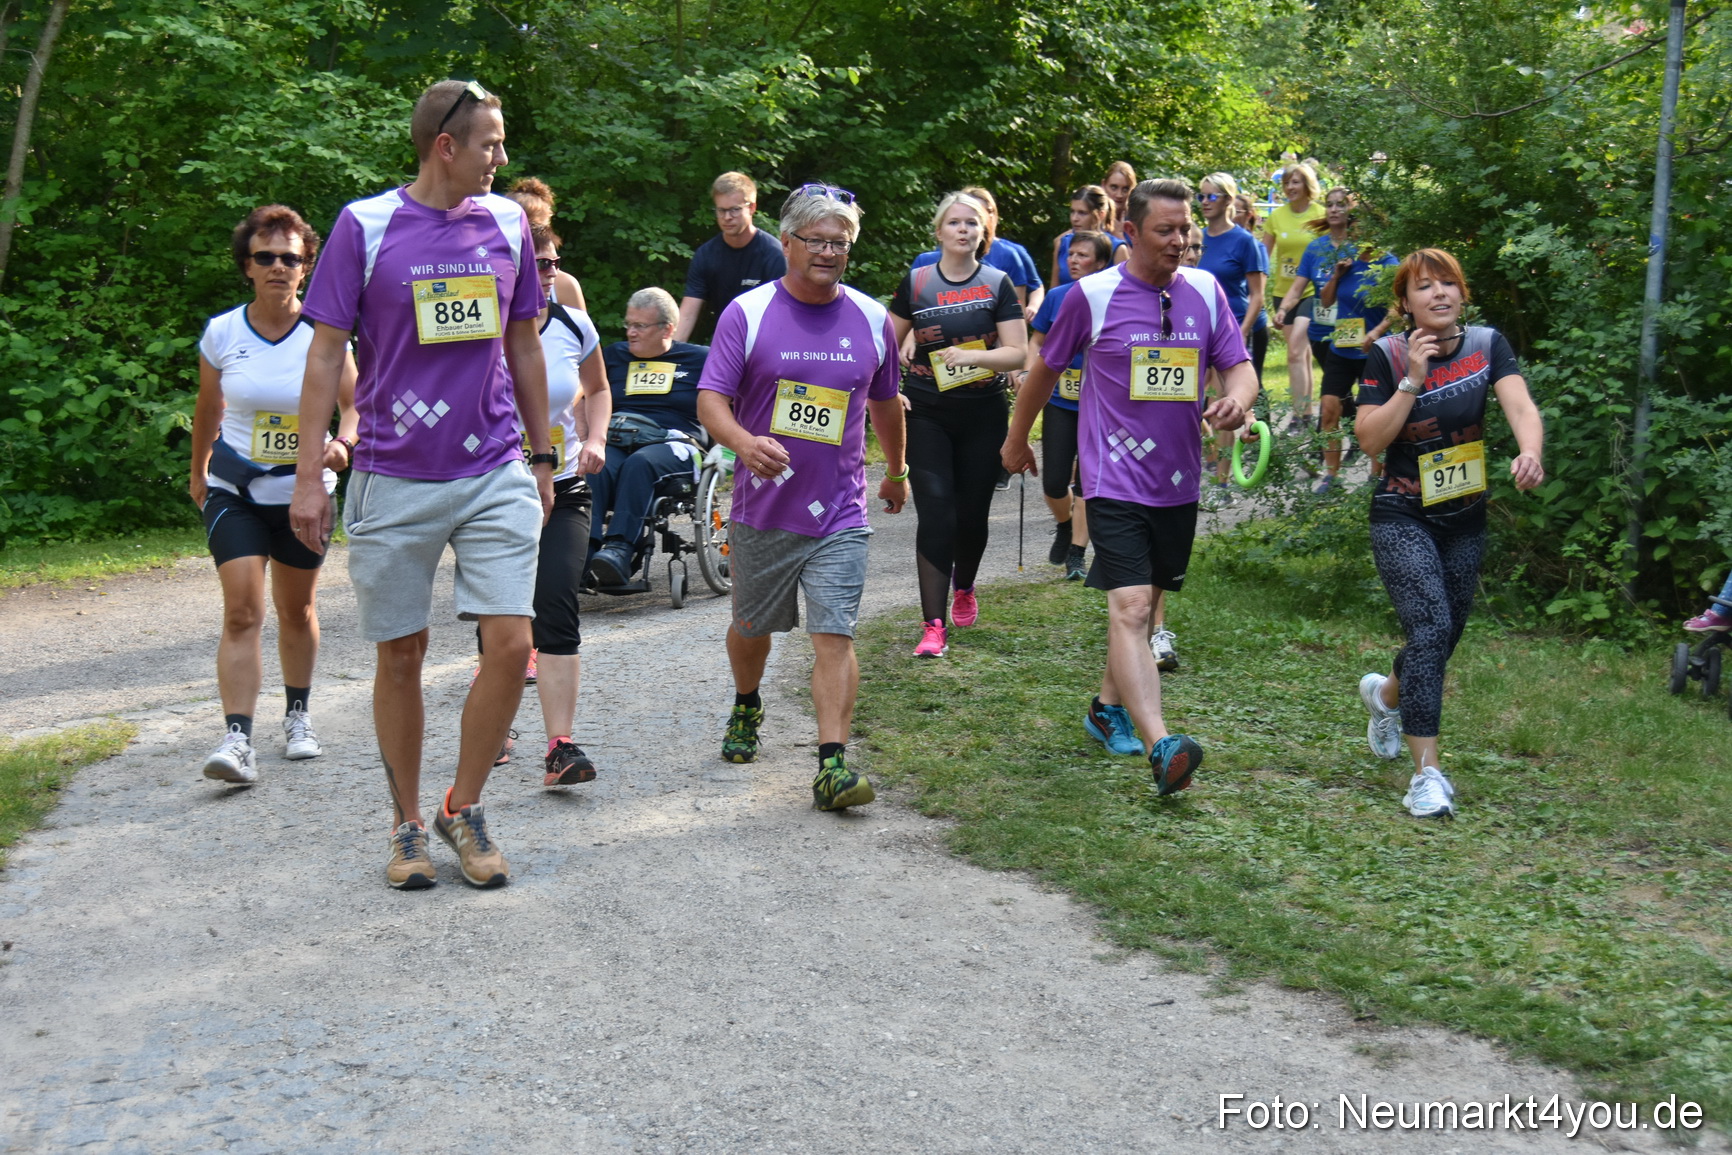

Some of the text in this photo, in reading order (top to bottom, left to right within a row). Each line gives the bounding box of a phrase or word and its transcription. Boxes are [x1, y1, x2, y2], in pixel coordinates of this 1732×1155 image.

[410, 263, 496, 275] WIR SIND LILA.
[936, 285, 993, 306] HAARE
[434, 299, 482, 324] 884
[436, 322, 484, 332] Ehbauer Daniel
[1130, 333, 1150, 341] WIR
[1179, 332, 1200, 341] LILA.
[780, 352, 856, 362] WIR SIND LILA.
[633, 373, 666, 385] 1429
[1147, 367, 1184, 386] 879
[1424, 350, 1488, 390] HAARE
[789, 402, 831, 427] 896
[809, 424, 825, 433] Erwin
[261, 431, 299, 450] 189
[1434, 462, 1467, 488] 971
